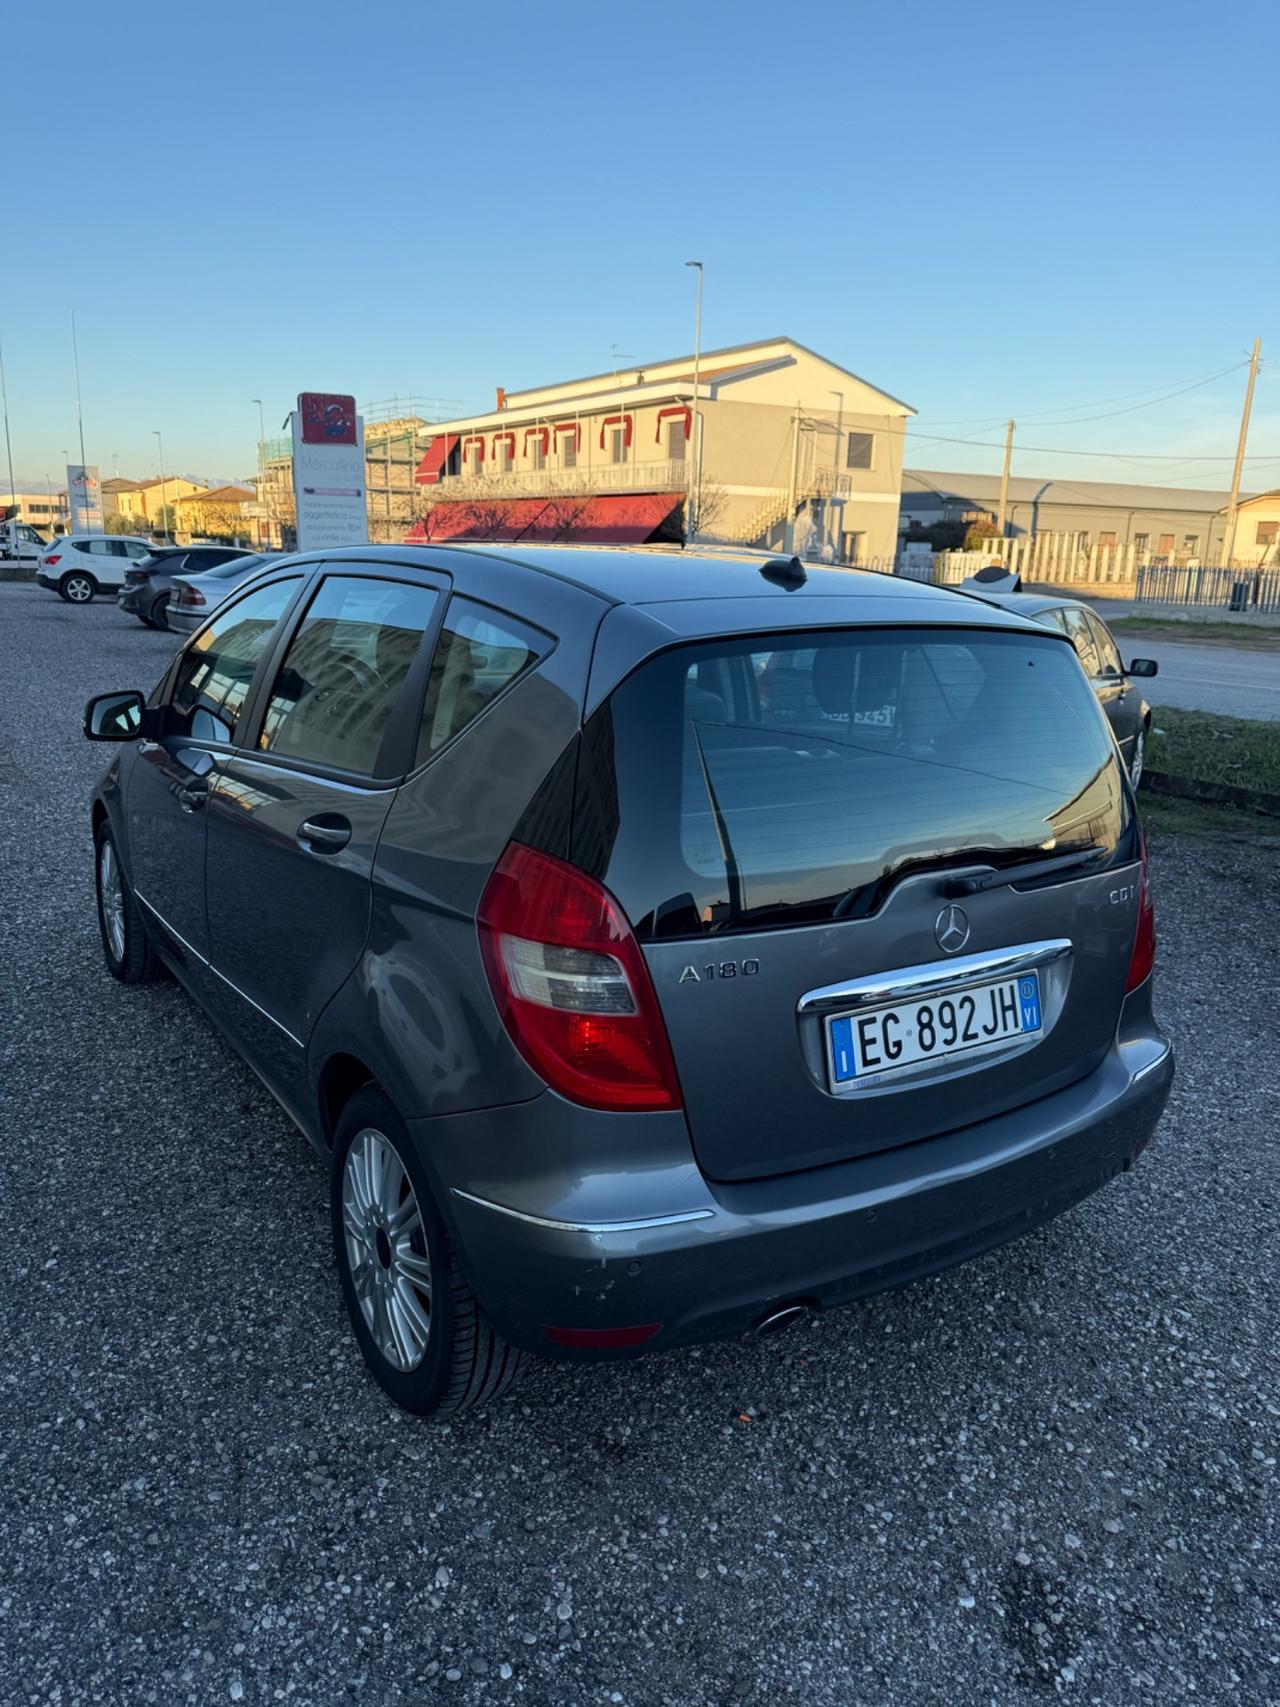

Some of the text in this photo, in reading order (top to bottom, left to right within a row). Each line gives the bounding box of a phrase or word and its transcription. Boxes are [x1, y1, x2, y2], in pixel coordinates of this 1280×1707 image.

[302, 457, 360, 473] Mercatino
[1023, 1006, 1038, 1027] VI
[841, 1050, 848, 1073] I
